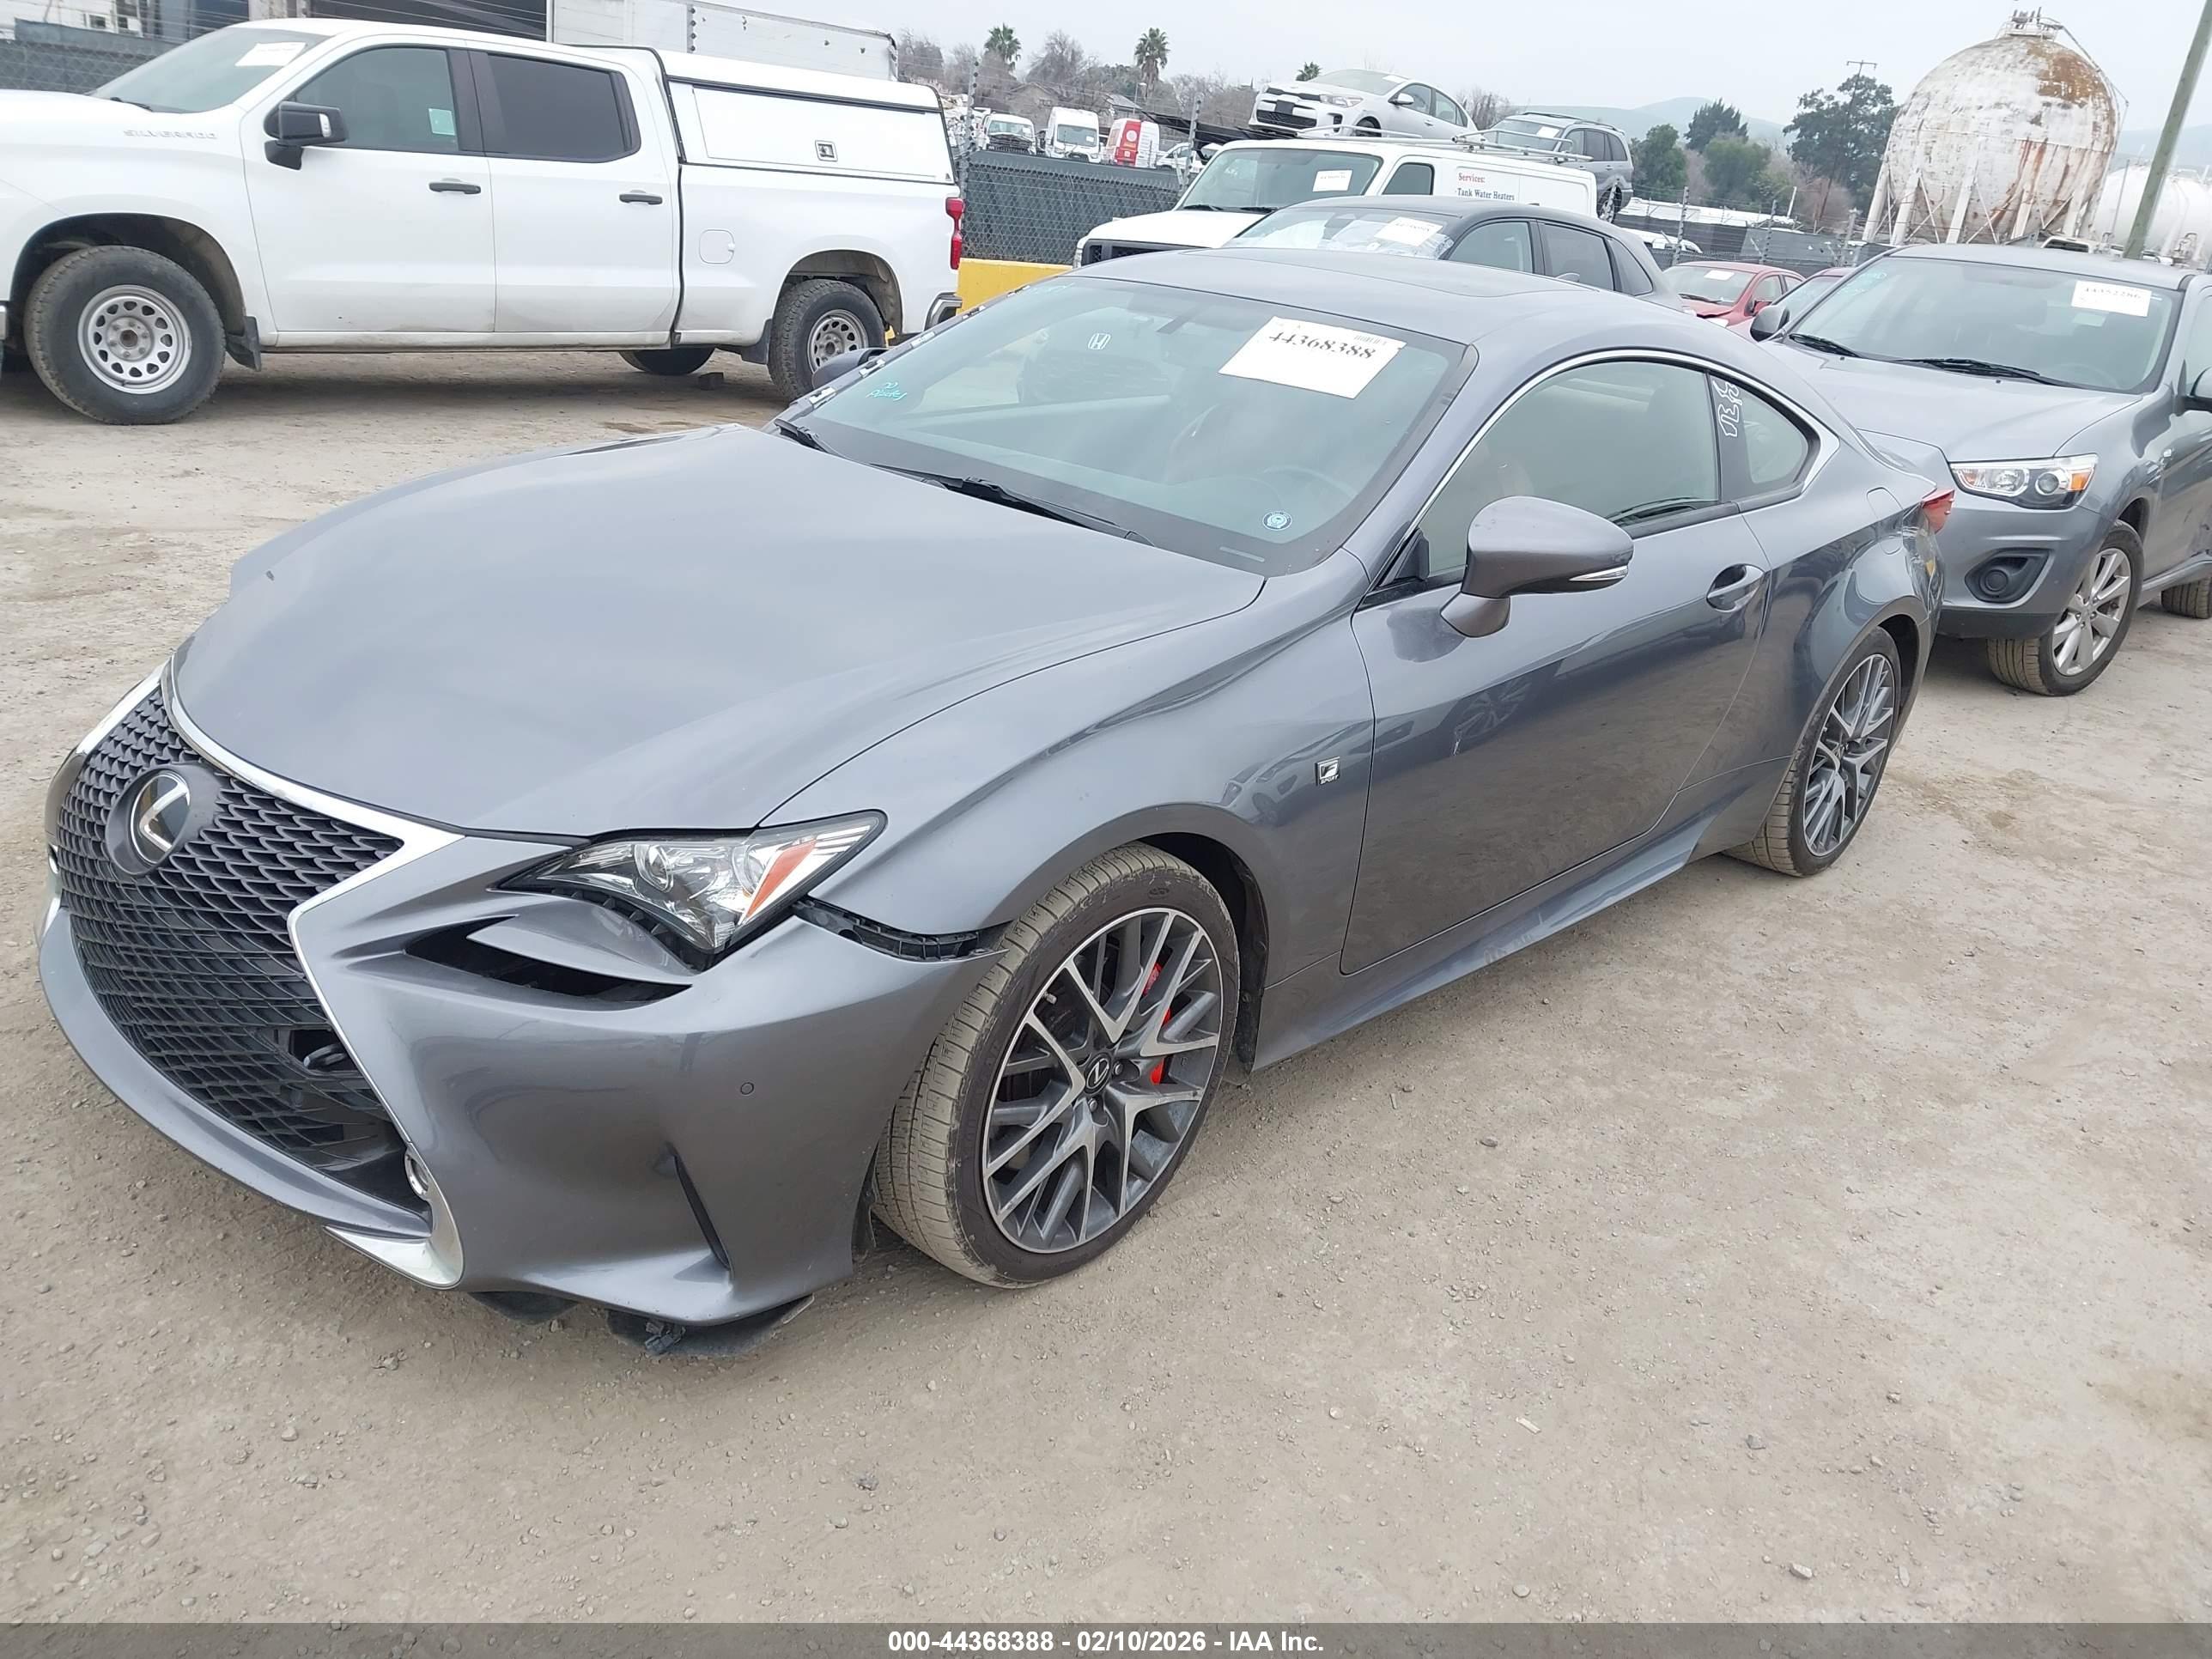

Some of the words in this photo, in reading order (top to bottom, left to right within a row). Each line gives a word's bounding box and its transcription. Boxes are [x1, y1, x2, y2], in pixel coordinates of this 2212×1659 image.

[1458, 173, 1486, 183] Services:
[1474, 189, 1492, 199] Water
[1493, 191, 1516, 201] Heaters
[1269, 331, 1376, 359] 44368388
